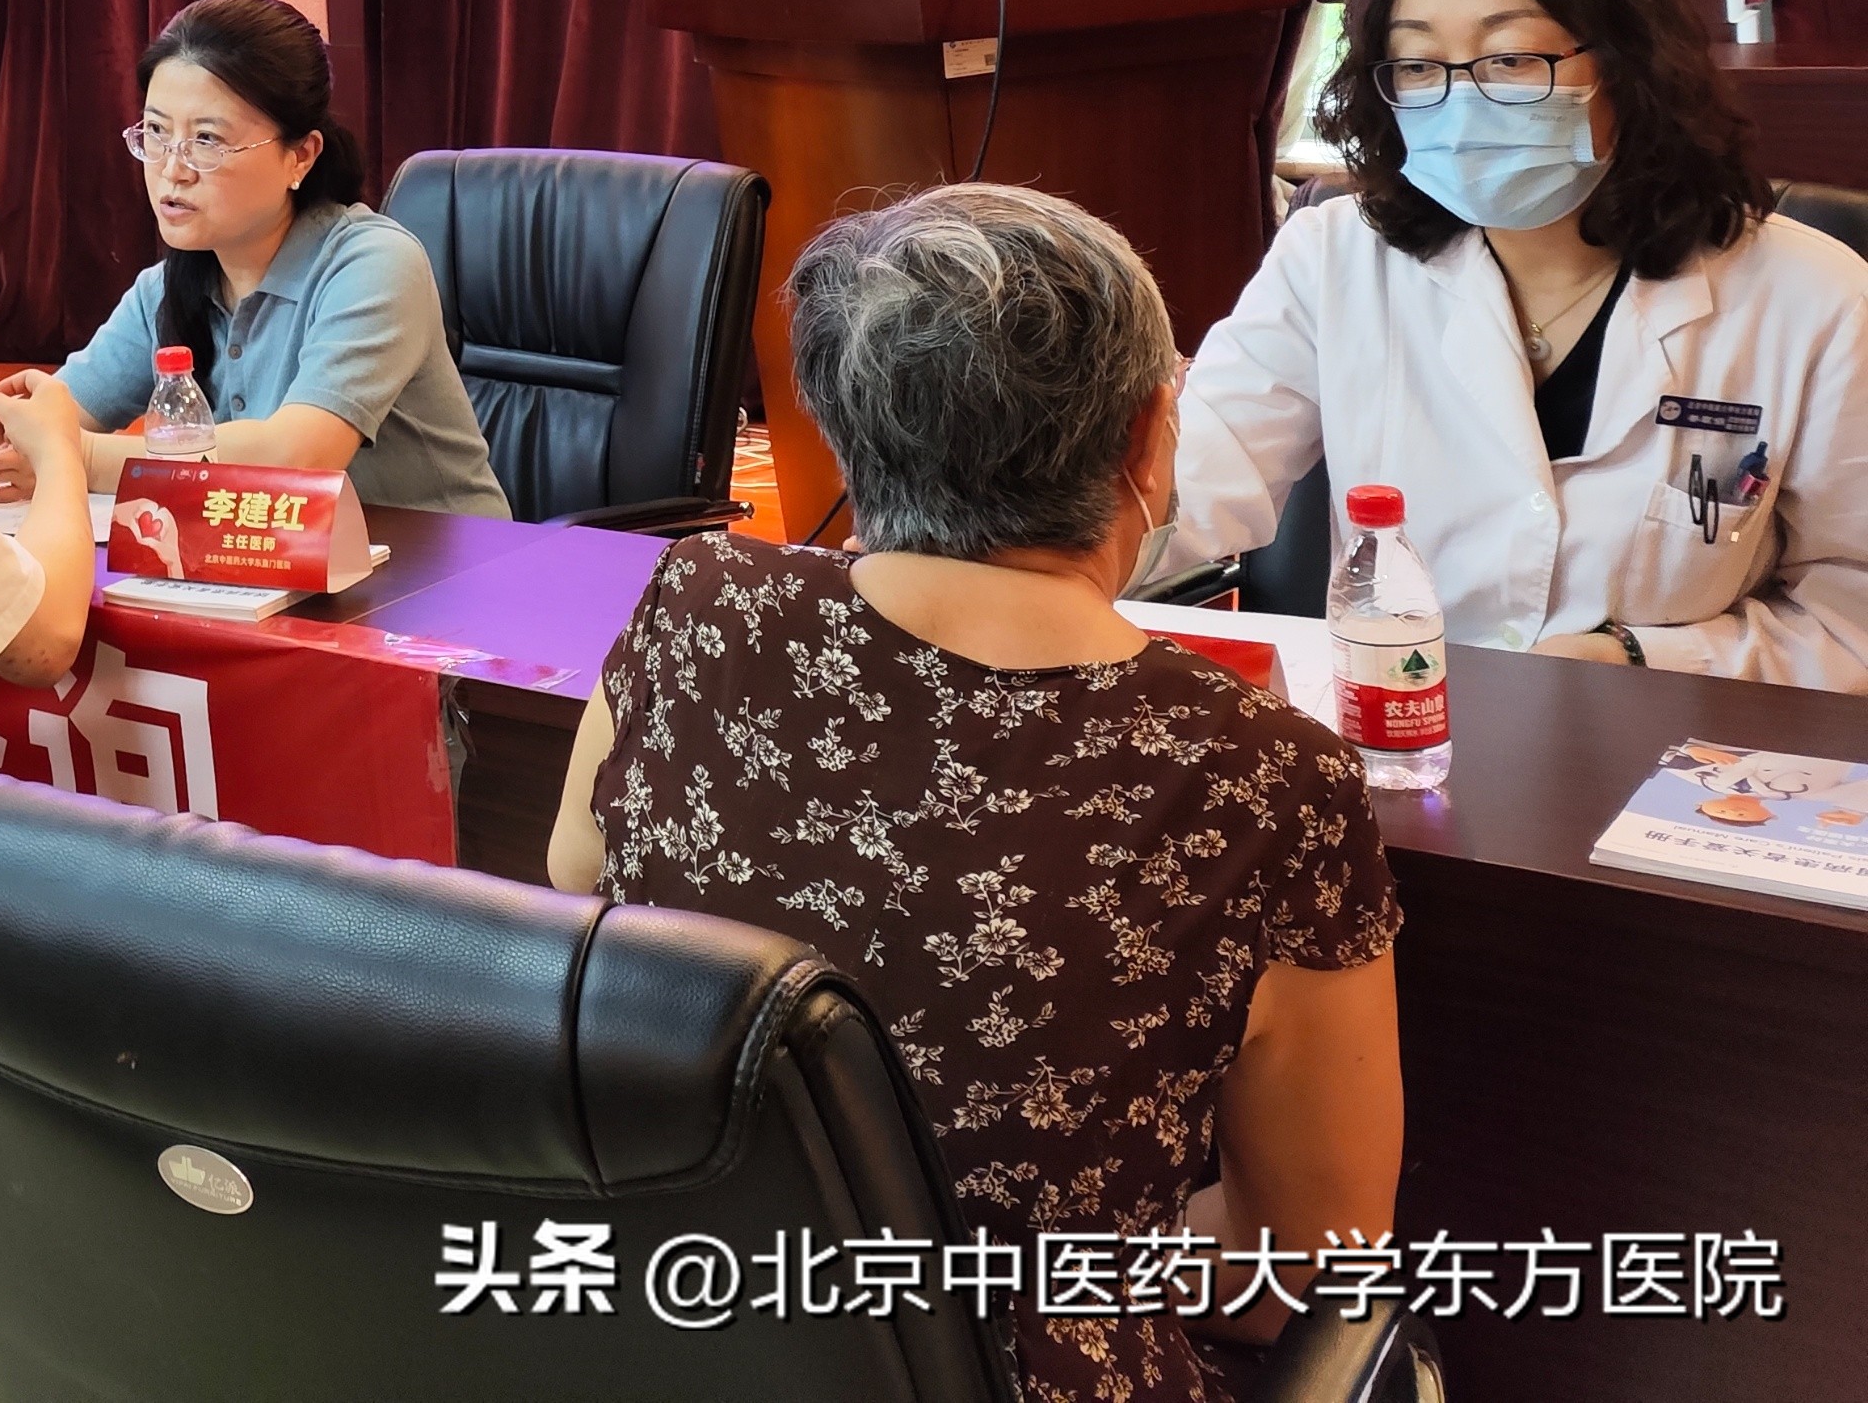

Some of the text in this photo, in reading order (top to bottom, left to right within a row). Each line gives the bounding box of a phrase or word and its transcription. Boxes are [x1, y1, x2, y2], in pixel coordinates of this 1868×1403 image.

[202, 488, 309, 532] 李建红
[221, 533, 277, 552] 主任医师
